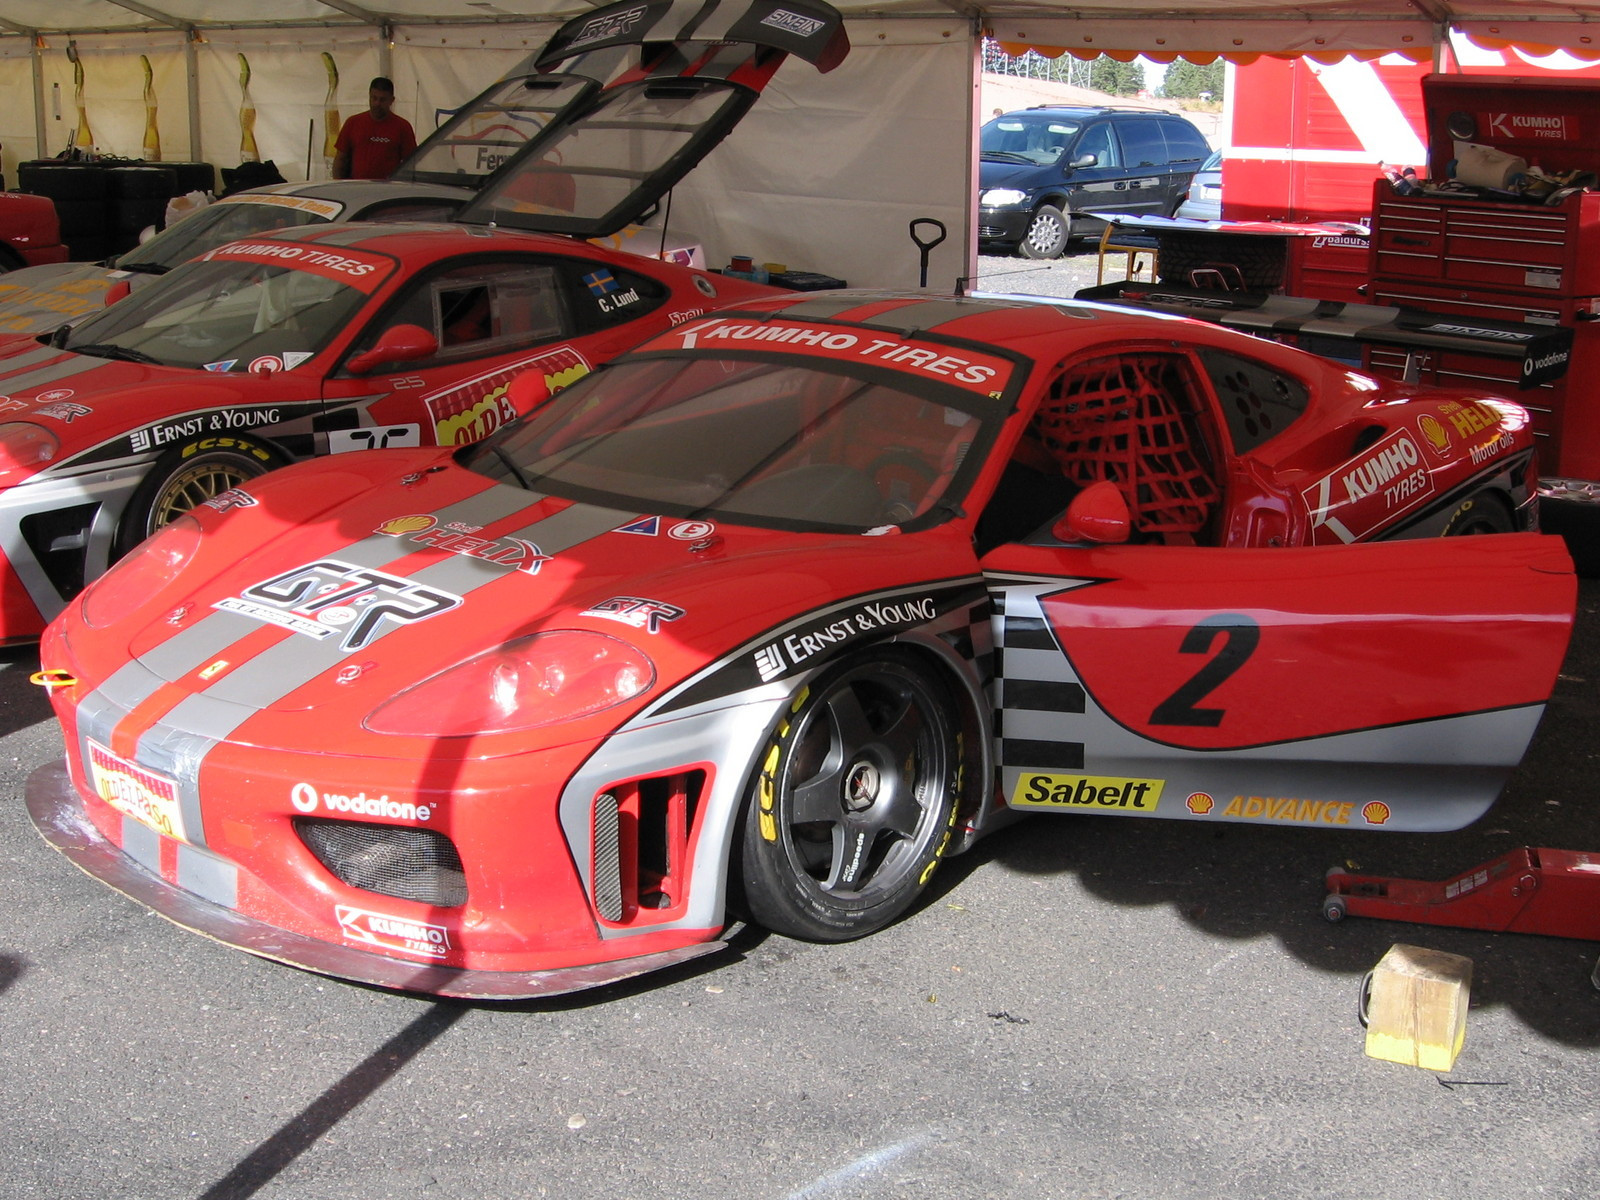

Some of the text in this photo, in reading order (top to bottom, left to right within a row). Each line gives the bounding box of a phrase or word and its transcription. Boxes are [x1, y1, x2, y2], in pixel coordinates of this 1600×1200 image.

[1512, 116, 1562, 128] KUMHO
[1535, 129, 1562, 138] TYRES
[476, 147, 510, 171] Fer
[219, 243, 375, 276] KUMHO TIRES
[598, 288, 640, 313] C. Lund
[703, 325, 997, 384] KUMHO TIRES
[1535, 351, 1568, 369] vodafone
[389, 375, 426, 390] 25
[1437, 400, 1464, 415] Shell
[152, 417, 204, 446] ERNST
[1469, 430, 1515, 466] Motor oils
[1342, 437, 1419, 504] KUMHO
[1384, 468, 1427, 509] TYRES
[444, 521, 484, 534] Shell
[409, 528, 554, 576] HELIX
[240, 559, 465, 653] GTR
[783, 618, 856, 665] ERNST
[1149, 612, 1261, 729] 2
[1025, 776, 1151, 808] Sabelt
[323, 793, 431, 821] vodafone
[1221, 795, 1357, 825] ADVANCE
[846, 832, 865, 883] speedline
[368, 917, 443, 944] KUMHO
[405, 939, 446, 954] TYRES
